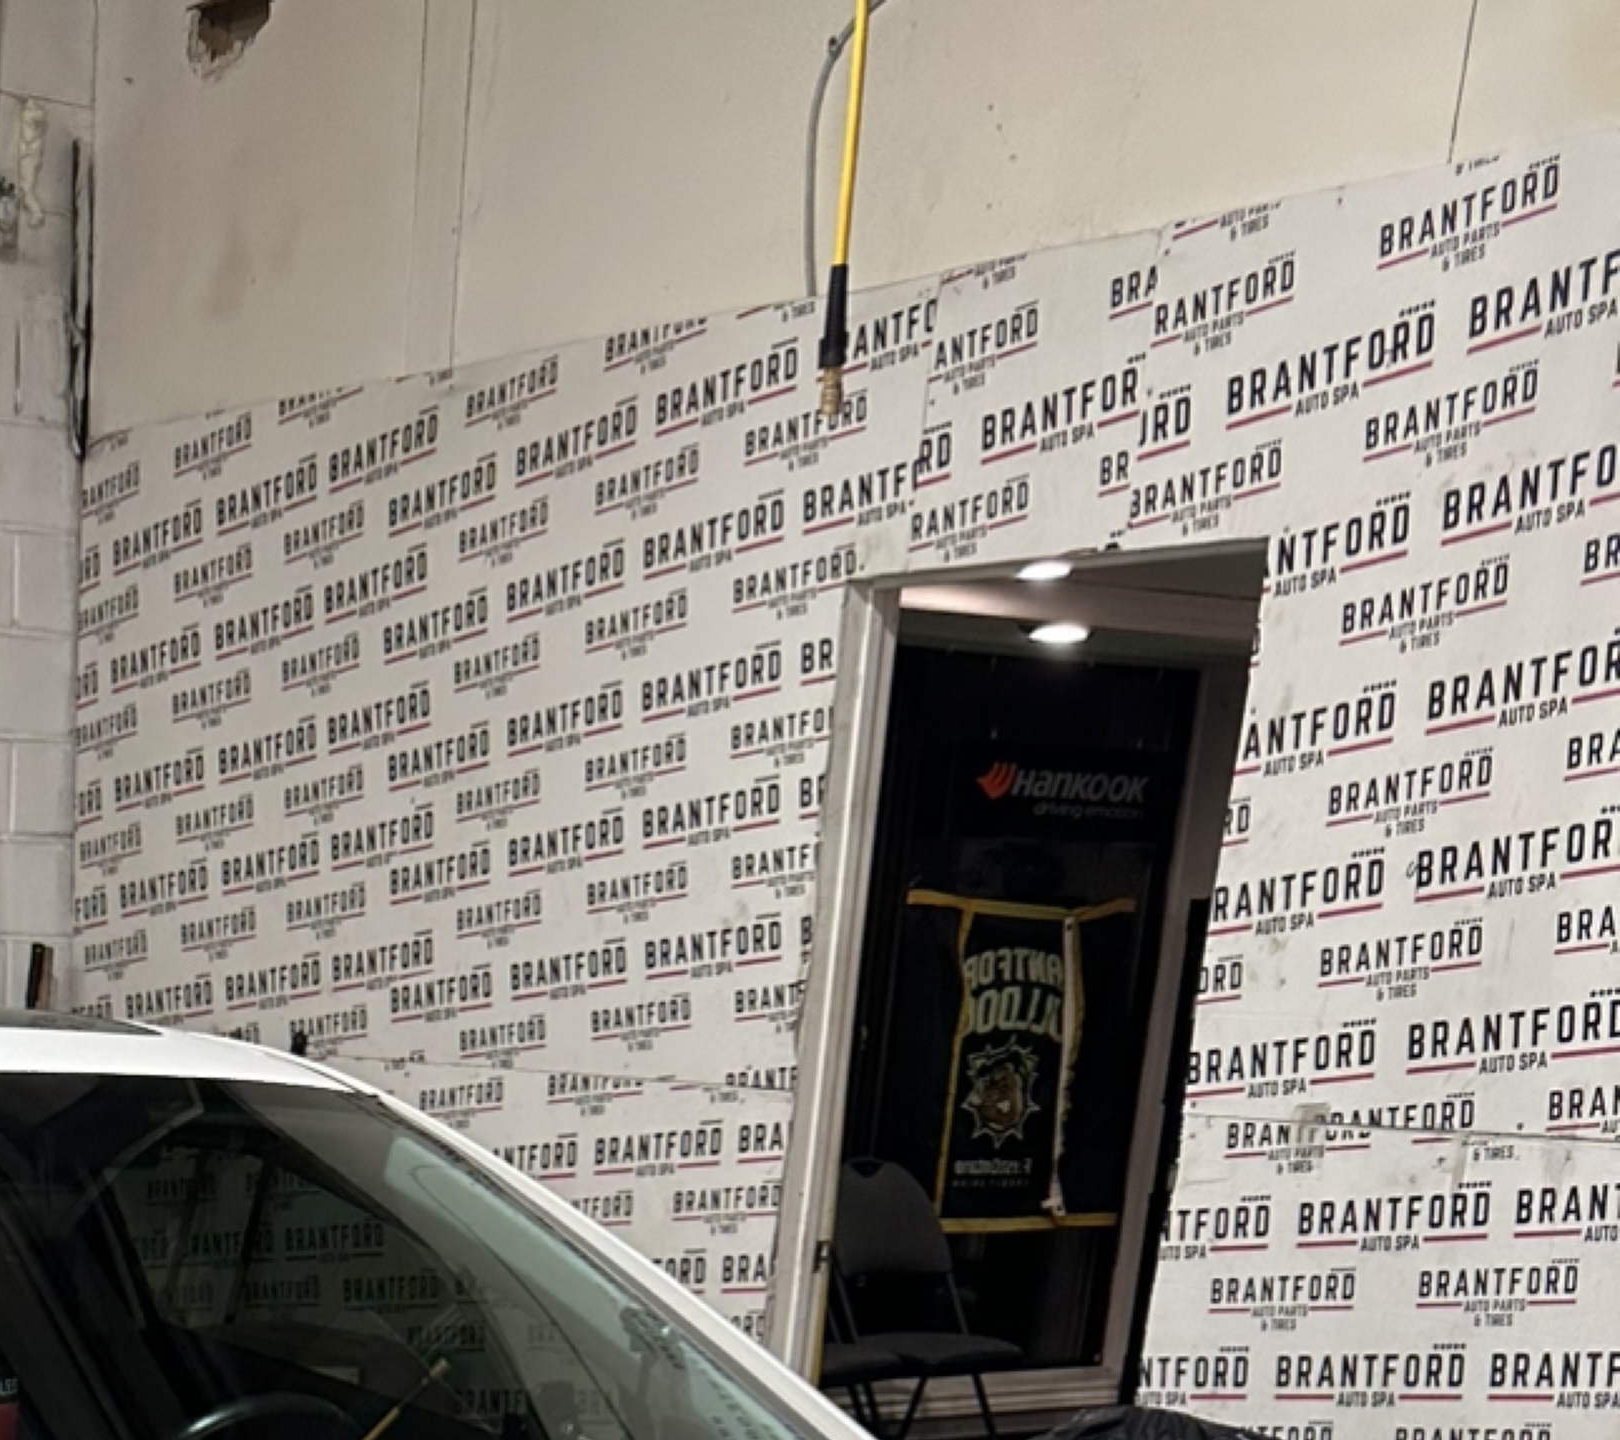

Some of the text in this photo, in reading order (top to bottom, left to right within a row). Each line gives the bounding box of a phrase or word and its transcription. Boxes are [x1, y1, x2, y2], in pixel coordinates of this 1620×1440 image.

[1380, 164, 1559, 257] BRANTFORD
[1154, 260, 1294, 335] RANTFORD
[1469, 250, 1620, 338] BRANTF
[935, 309, 1038, 370] ANTFORD
[1544, 299, 1618, 338] AUTO SPA
[655, 348, 797, 424] BRANTFORD
[1228, 313, 1435, 416] BRANTFORD
[467, 360, 558, 418] BRANTFORD
[982, 368, 1138, 450] BRANTFOR
[1295, 382, 1359, 417] AUTO SPA
[1366, 369, 1538, 449] BRANTFORD
[329, 414, 438, 482] BRANTFORD
[517, 404, 637, 476] BRANTFORD
[1040, 422, 1094, 452] AUTO SPA
[216, 463, 317, 526] BRANTFORD
[389, 462, 496, 527] BRANTFORD
[596, 449, 699, 506] BRANTFORD
[1443, 445, 1616, 530] BRANTFO
[284, 503, 364, 555] BRANTFORD
[459, 501, 548, 552] BRANTFORD
[643, 500, 784, 568] BRANTFORD
[912, 481, 1029, 540] RANTFORD
[1515, 500, 1585, 533] AUTO SPA
[113, 506, 203, 566] BRANTFORD
[1278, 505, 1409, 576] NTFORD
[174, 547, 251, 593] BRANTFORD
[325, 551, 427, 612] BRANTFORD
[507, 548, 623, 611] BRANTFORD
[733, 549, 857, 603] BRANTFORD
[1274, 566, 1336, 597] AUTO SPA
[215, 593, 312, 650] BRANTFORD
[585, 594, 687, 644] BRANTFORD
[1342, 564, 1508, 633] BRANTFORD
[384, 596, 487, 654] BRANTFORD
[112, 622, 201, 683] BRANTFORD
[282, 637, 359, 682] BRANTFORD
[454, 637, 540, 684] BRANTFORD
[172, 672, 251, 714] BRANTFORD
[643, 651, 781, 711] BRANTFORD
[328, 688, 430, 743] BRANTFORD
[507, 689, 622, 746] BRANTFORD
[1243, 692, 1395, 762] ANTFORD
[1498, 698, 1568, 728] AUTO SPA
[219, 722, 316, 774] BRANTFORD
[388, 728, 489, 782] BRANTFORD
[585, 738, 686, 782] BRANTFORD
[1263, 752, 1324, 777] AUTO SPA
[116, 755, 204, 802] BRANTFORD
[284, 768, 363, 809] BRANTFORD
[457, 772, 540, 814] BRANTFORD
[1329, 755, 1492, 815] BRANTFORD
[176, 798, 253, 836] BRANTFORD
[643, 784, 780, 838] BRANTFORD
[1375, 800, 1438, 824] AUTO PARTS
[331, 811, 433, 860] BRANTFORD
[509, 816, 623, 867] BRANTFORD
[1415, 818, 1614, 888] BRANTFOR
[222, 840, 319, 884] BRANTFORD
[390, 848, 489, 895] BRANTFORD
[587, 866, 688, 905] BRANTFORD
[1487, 872, 1556, 898] AUTO SPA
[120, 867, 208, 909] BRANTFORD
[287, 886, 365, 922] BRANTFORD
[457, 892, 541, 930] BRANTFORD
[1214, 859, 1383, 922] RANTFORD
[181, 909, 255, 944] BRANTFORD
[645, 921, 781, 970] BRANTFORD
[1255, 912, 1314, 935] AUTO SPA
[333, 938, 432, 981] BRANTFORD
[511, 946, 627, 990] BRANTFORD
[1320, 923, 1482, 977] BRANTFORD
[126, 981, 212, 1018] BRANTFORD
[226, 960, 319, 1000] BRANTFORD
[391, 972, 491, 1013] BRANTFORD
[1365, 967, 1429, 986] AUTO PARTS
[460, 1018, 545, 1050] BRANTFORD
[592, 997, 691, 1032] BRANTFORD
[1187, 1029, 1376, 1085] BRANTFORD
[1479, 1050, 1548, 1074] AUTO SPA
[419, 1080, 503, 1111] BRANTFORD
[1247, 1078, 1307, 1099] AUTO SPA
[595, 1128, 722, 1165] BRANTFORD
[1298, 1192, 1489, 1235] BRANTFORD
[1359, 1234, 1420, 1253] AUTO SPA
[1210, 1272, 1355, 1304] BRANTFORD
[1419, 1265, 1578, 1297] BRANTFORD
[1464, 1299, 1525, 1313] AUTO PARTS
[1275, 1354, 1464, 1388] BRANTFORD
[1490, 1353, 1620, 1387] BRANTF
[1336, 1392, 1396, 1406] AUTO SPA
[1556, 1393, 1620, 1409] AUTO SPA
